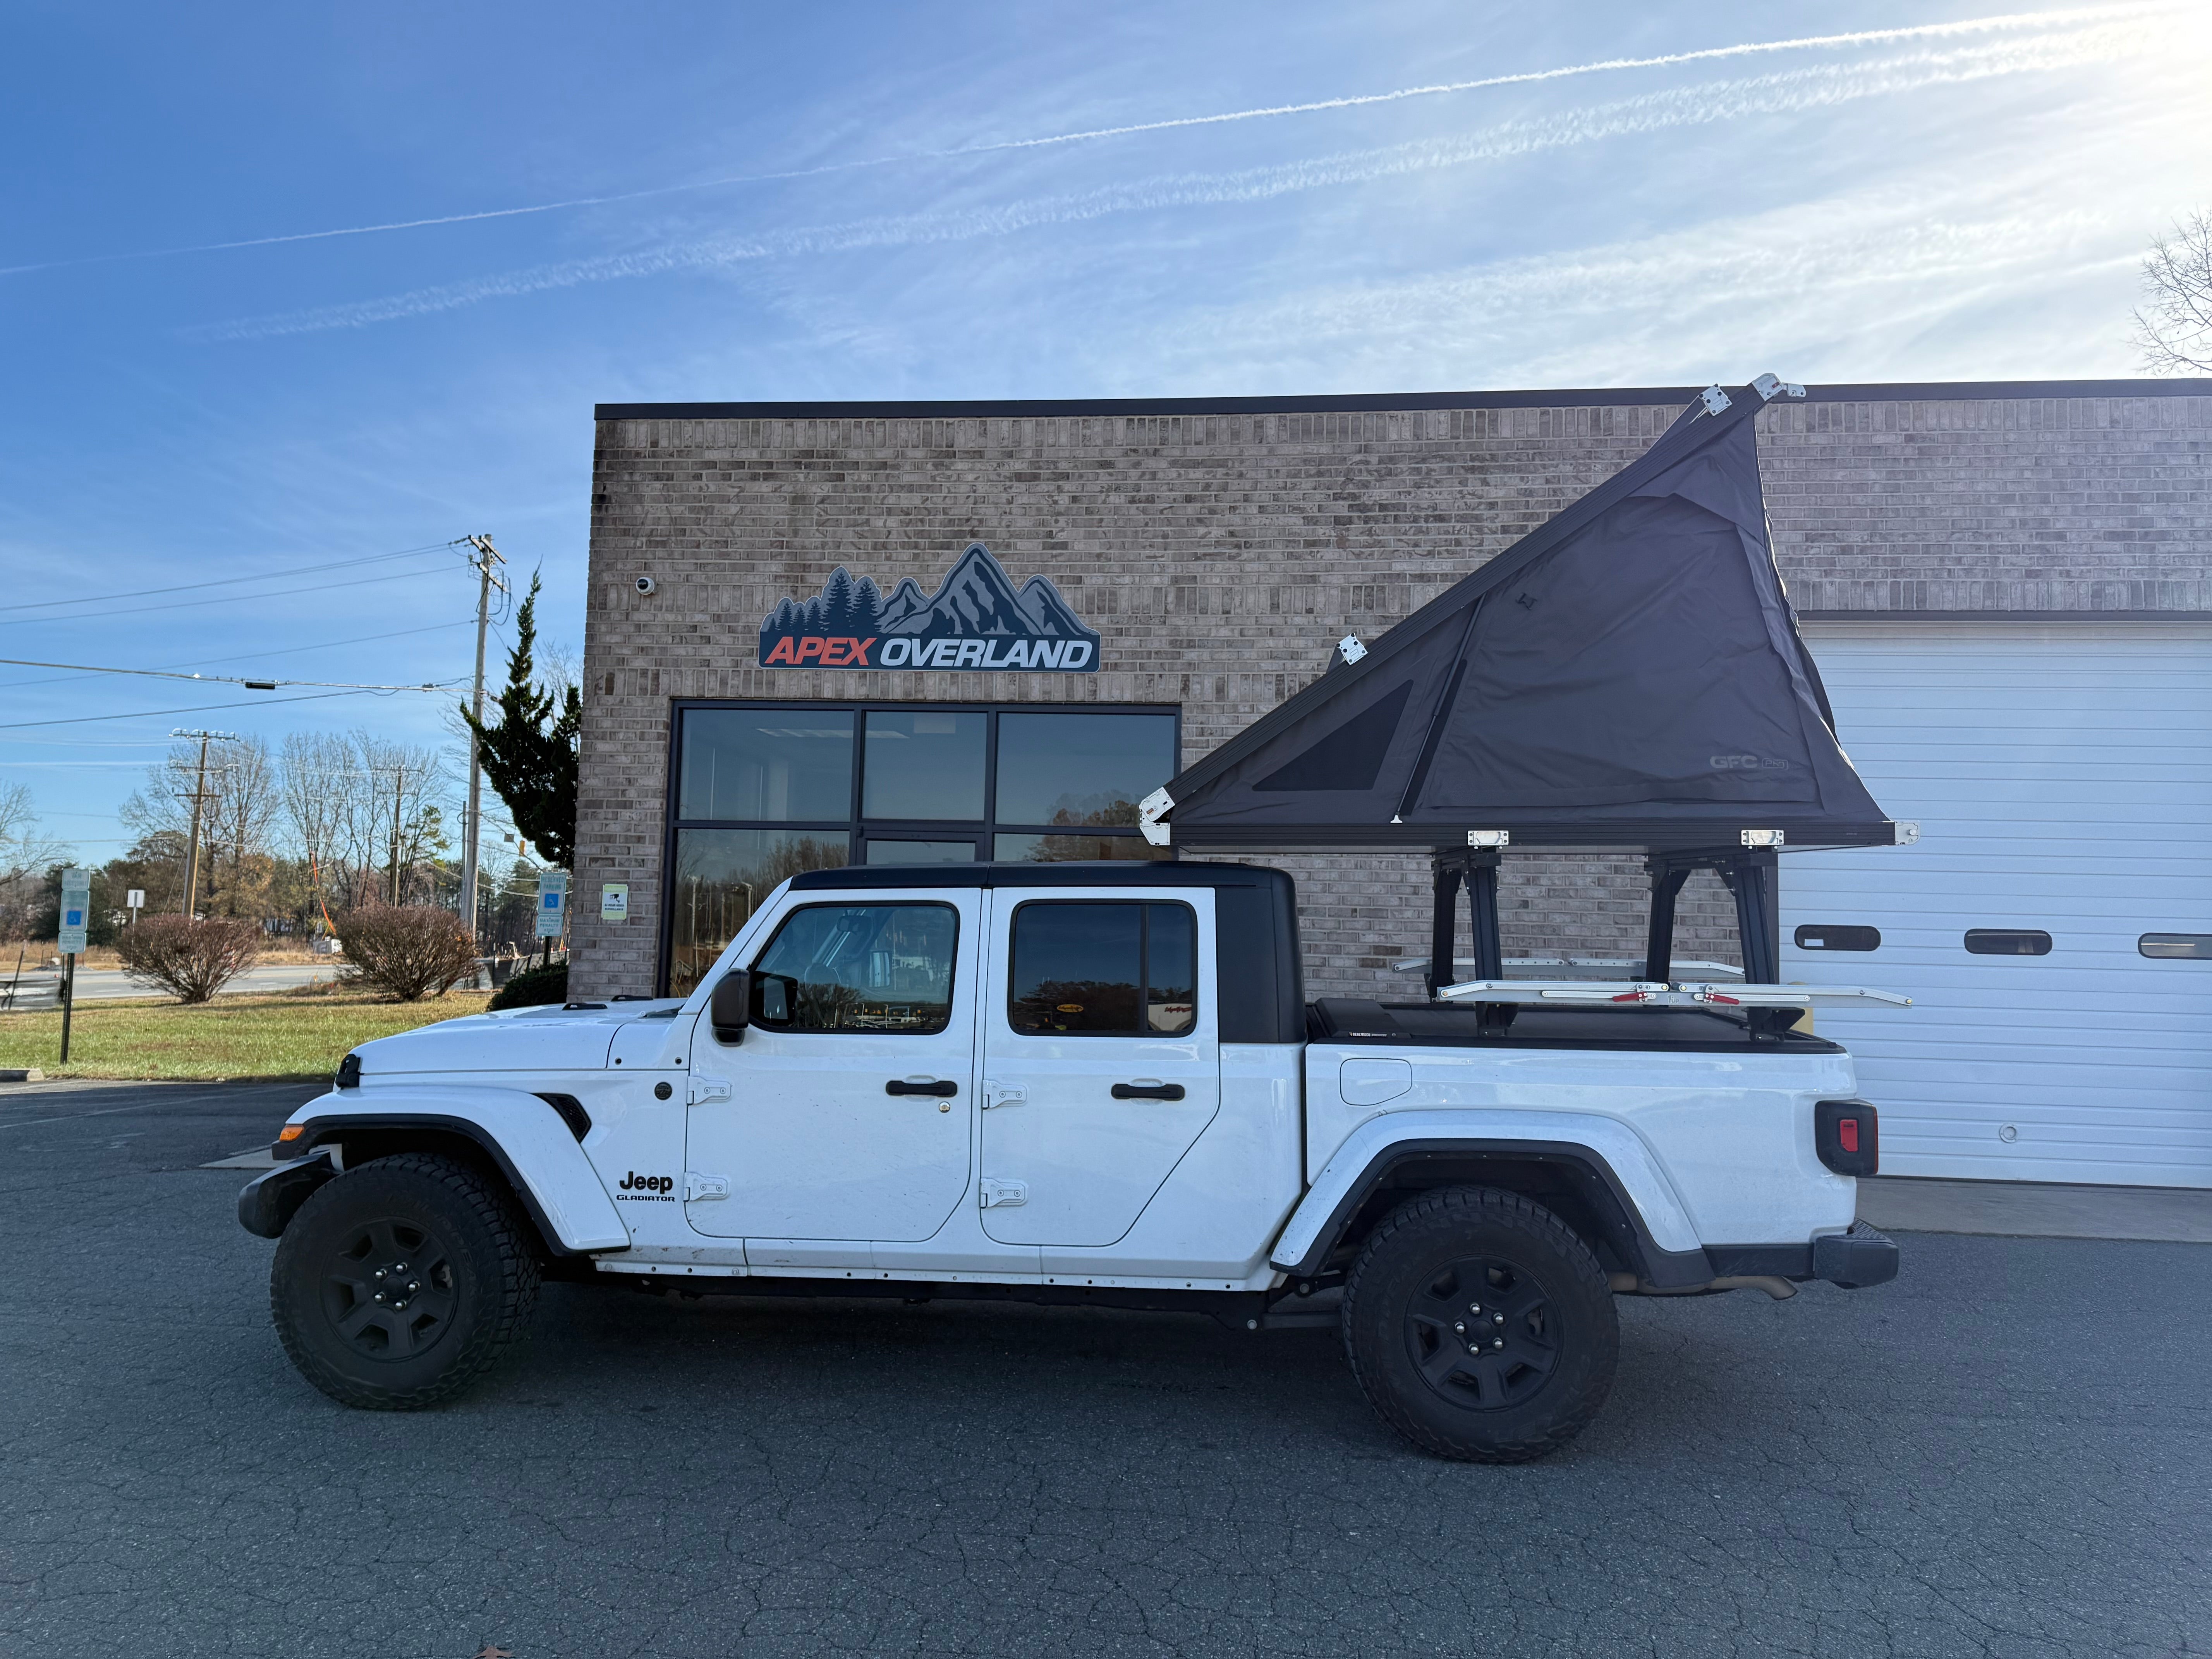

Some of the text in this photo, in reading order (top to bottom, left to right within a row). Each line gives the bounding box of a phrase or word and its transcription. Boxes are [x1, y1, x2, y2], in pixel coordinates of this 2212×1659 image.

[764, 636, 1092, 668] APEX OVERLAND
[1710, 756, 1757, 769] GFC
[619, 1171, 673, 1194] Jeep
